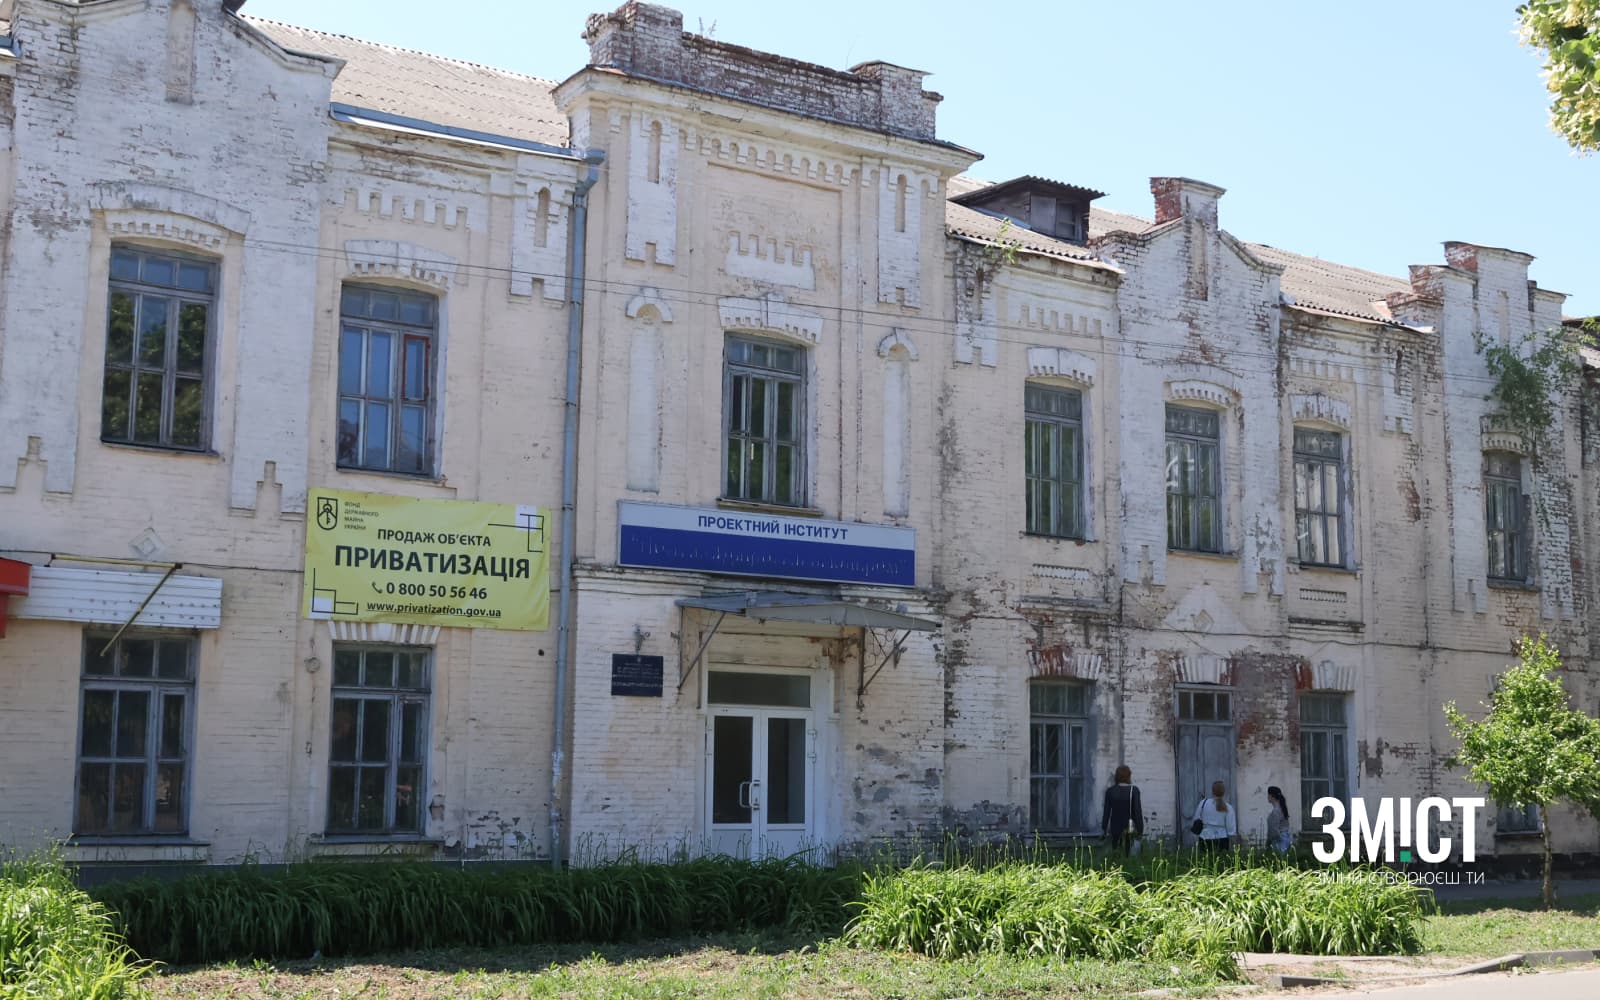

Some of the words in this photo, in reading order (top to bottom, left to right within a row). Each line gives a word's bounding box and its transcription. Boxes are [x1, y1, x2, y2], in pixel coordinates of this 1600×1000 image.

[698, 515, 780, 534] ПРОЕКТНИЙ
[784, 524, 849, 540] ІНСТИТУТ
[377, 528, 435, 545] ПРОДАЖ
[438, 533, 491, 547] ОБ’ЄКТА
[335, 545, 530, 582] ПРИВАТИЗАЦІЯ
[386, 582, 395, 594] 0
[398, 583, 425, 596] 800
[429, 585, 446, 597] 50
[449, 586, 467, 598] 56
[469, 587, 488, 600] 46
[367, 602, 502, 619] www.privatization.gov.ua
